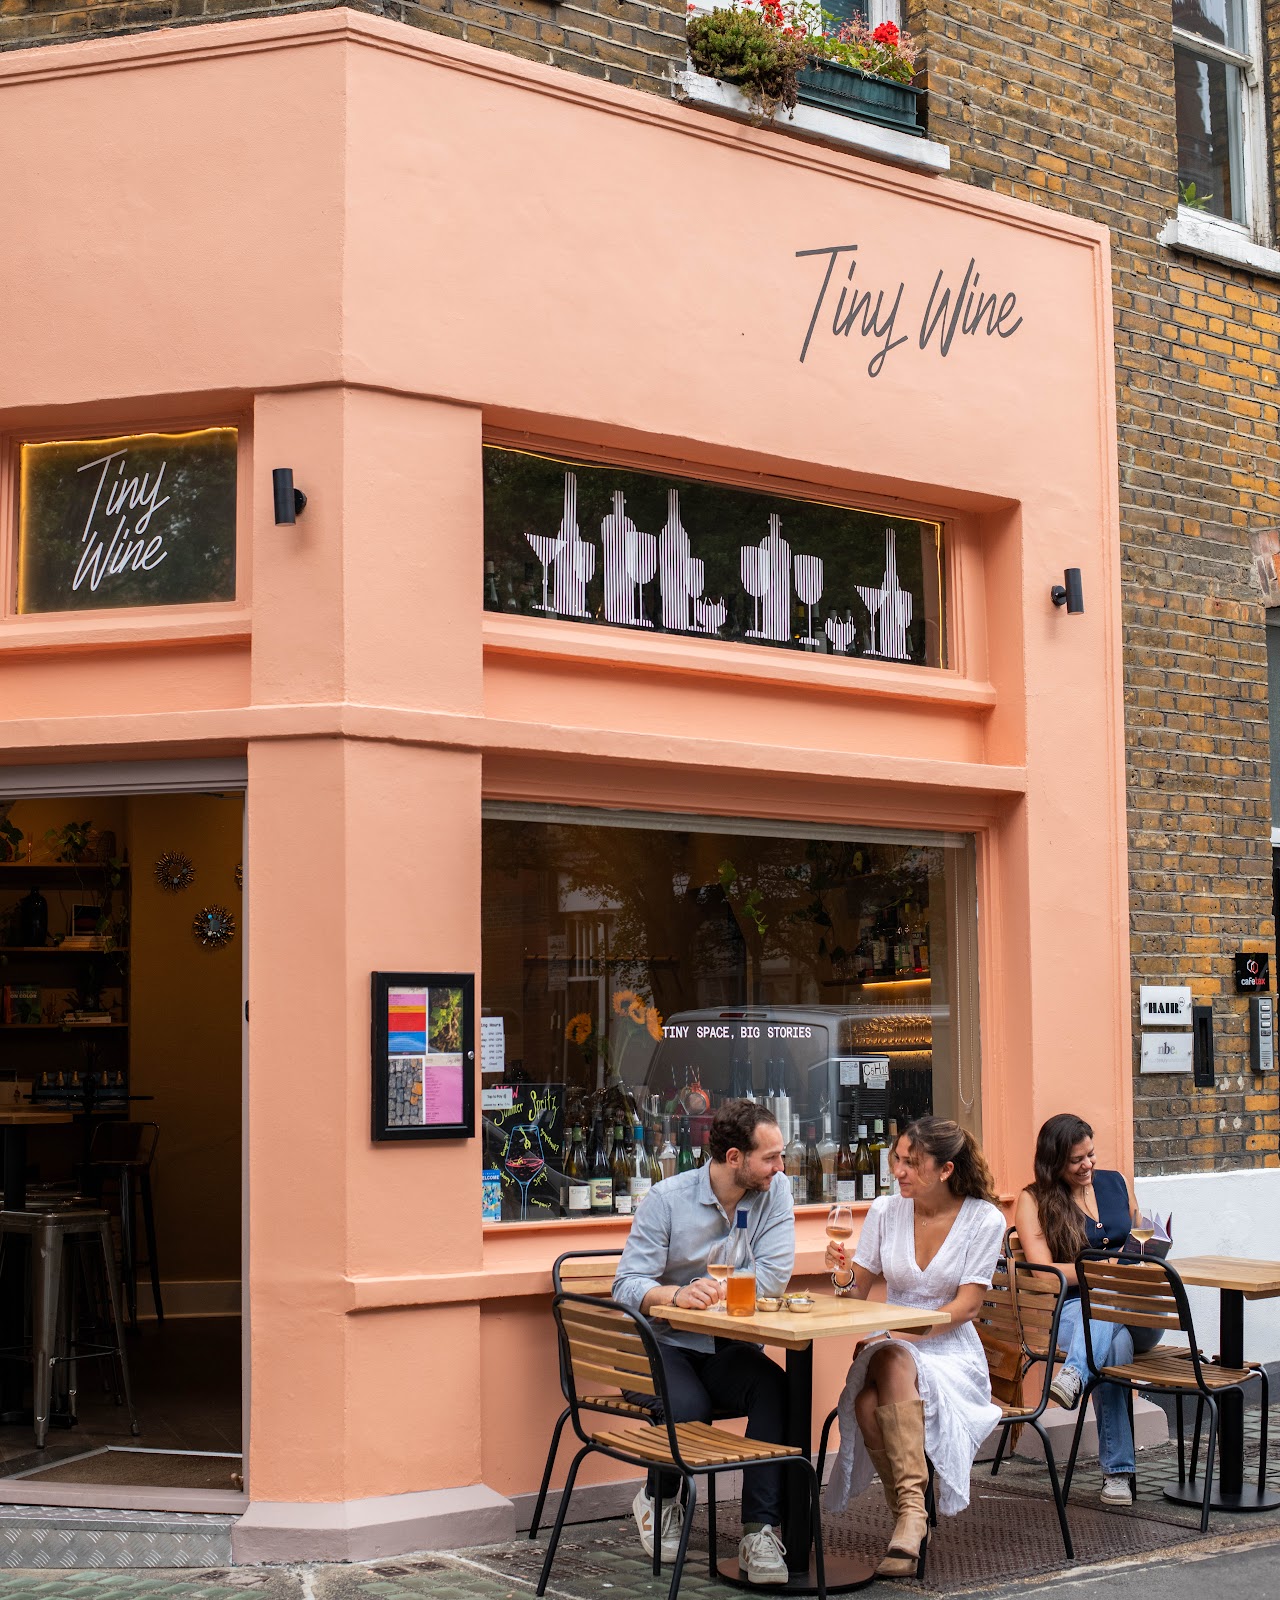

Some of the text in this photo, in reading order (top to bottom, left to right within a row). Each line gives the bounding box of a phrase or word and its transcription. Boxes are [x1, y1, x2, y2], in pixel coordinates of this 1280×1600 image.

[795, 244, 1024, 378] Tiny Wine
[77, 448, 170, 542] Tiny
[72, 515, 168, 591] Wine
[663, 1026, 812, 1040] TINY SPACE, BIG STORIES
